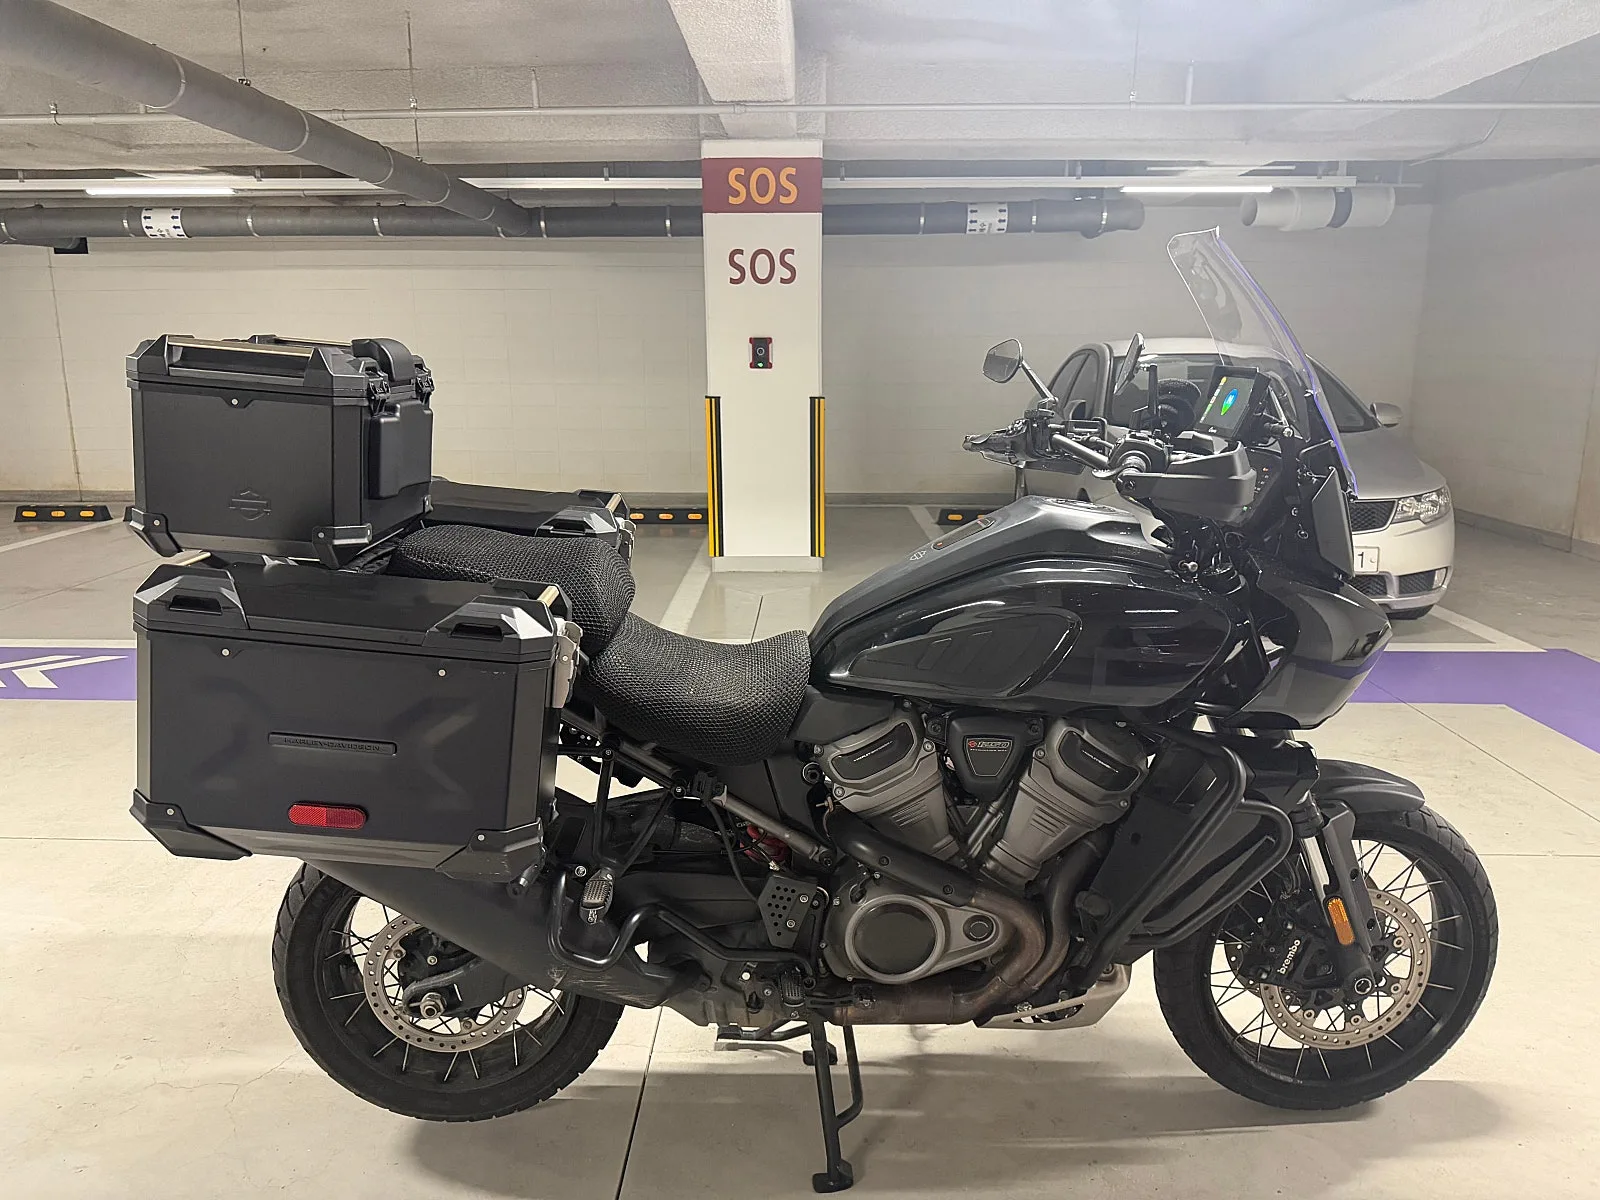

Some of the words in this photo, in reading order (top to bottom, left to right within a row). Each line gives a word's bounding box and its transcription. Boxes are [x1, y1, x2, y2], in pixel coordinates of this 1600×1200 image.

[728, 167, 798, 204] SOS
[728, 248, 797, 285] SOS
[1276, 939, 1301, 974] brembo
